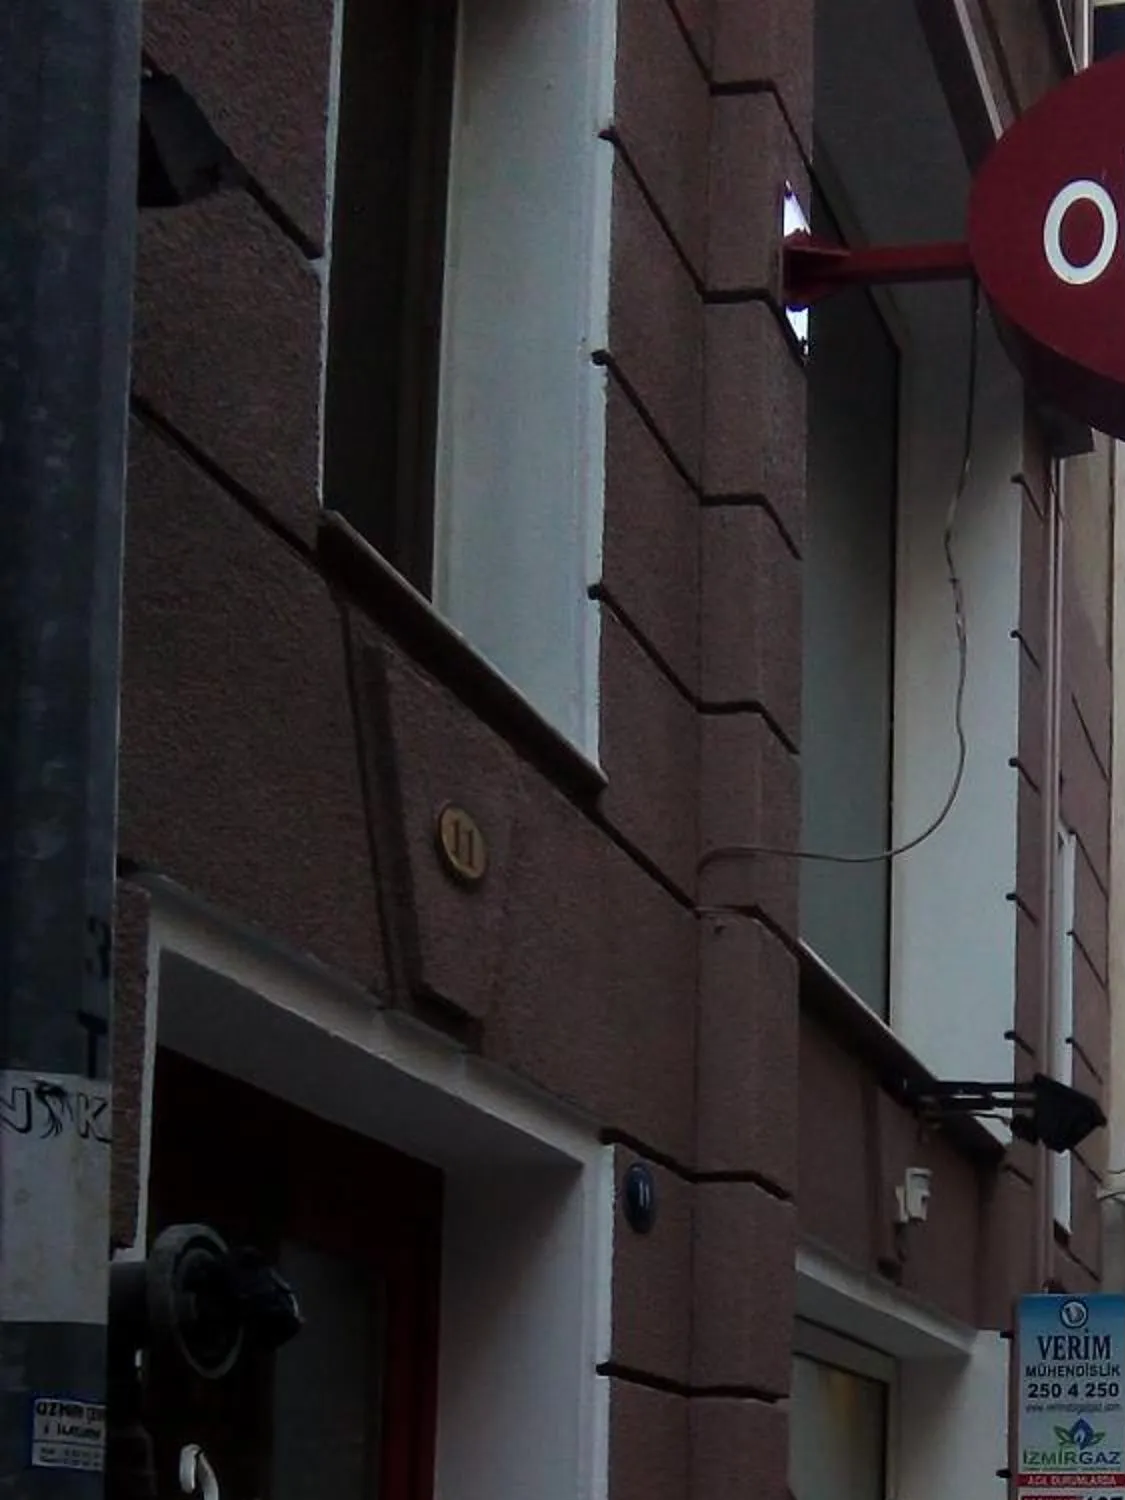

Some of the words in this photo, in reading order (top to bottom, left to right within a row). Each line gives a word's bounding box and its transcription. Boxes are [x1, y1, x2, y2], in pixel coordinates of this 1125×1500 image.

[1038, 1328, 1111, 1361] VERİM
[1025, 1363, 1121, 1377] MÜHENDİSLİK
[1027, 1383, 1062, 1398] 250
[1067, 1383, 1078, 1397] 4
[1086, 1382, 1119, 1397] 250
[1023, 1449, 1121, 1465] İZMİRGAZ
